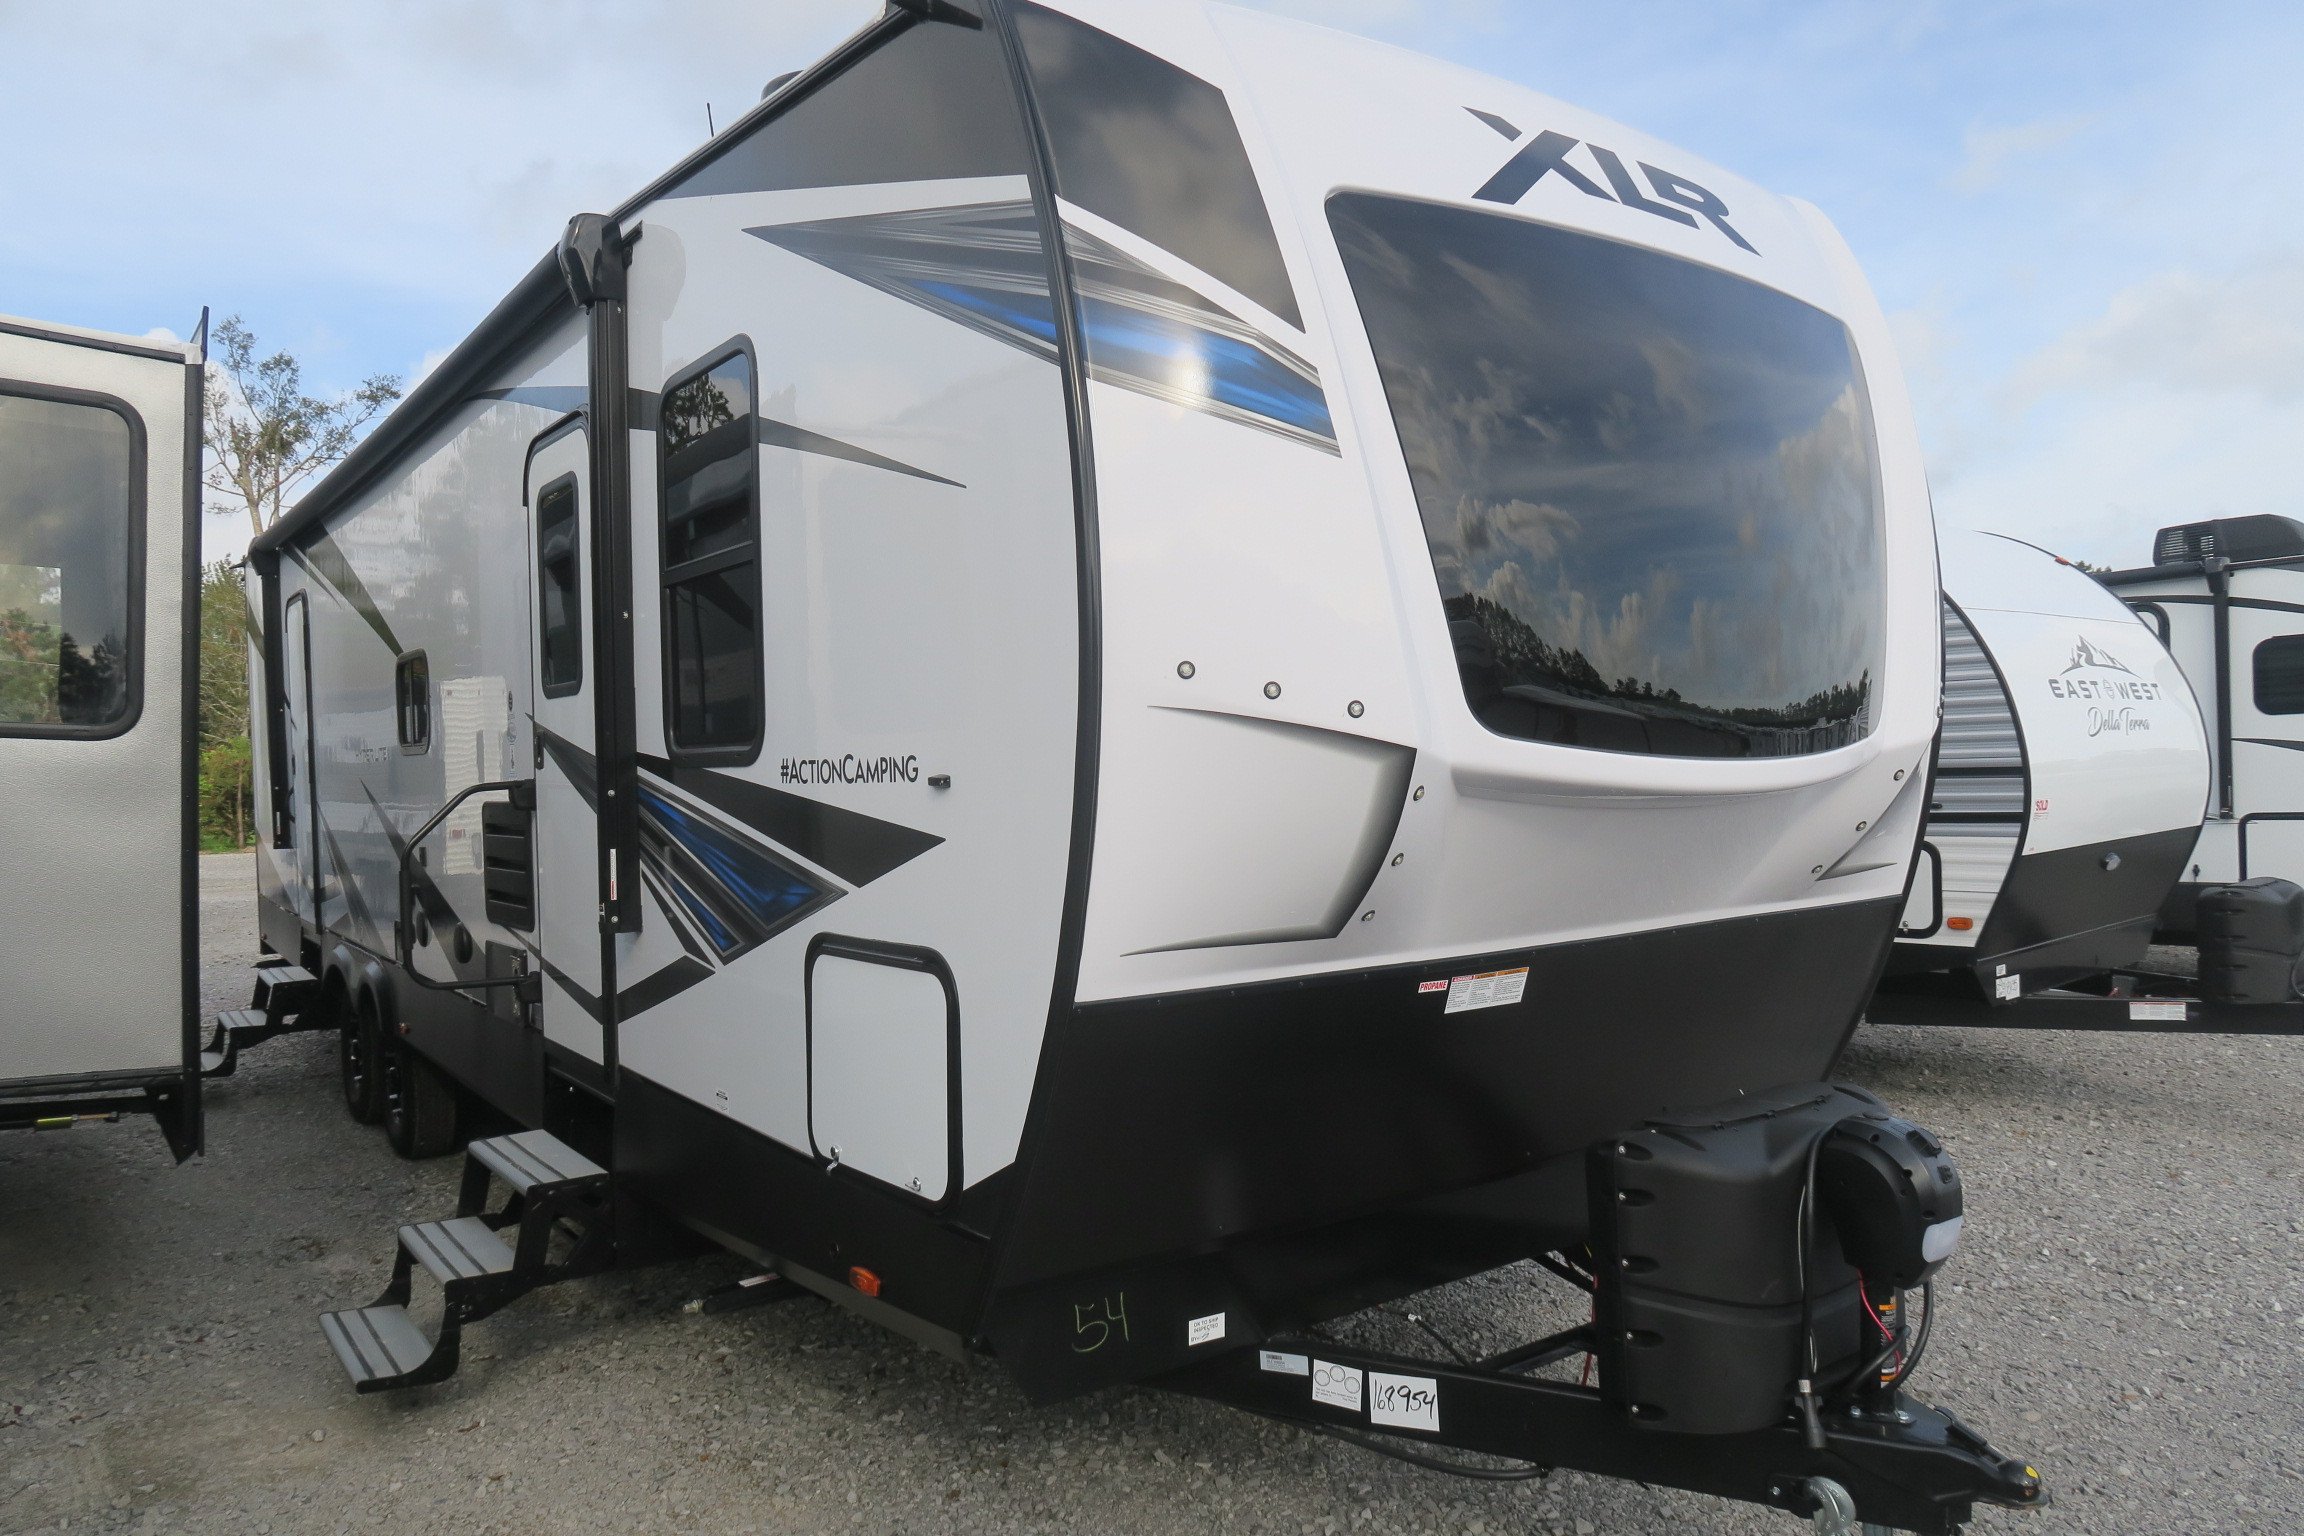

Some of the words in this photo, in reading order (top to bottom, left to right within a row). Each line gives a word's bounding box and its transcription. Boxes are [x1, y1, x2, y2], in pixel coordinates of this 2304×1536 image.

[1460, 105, 1763, 258] XLR
[2048, 678, 2101, 699] EAST
[2114, 681, 2162, 701] WEST
[2087, 706, 2121, 738] Della
[2118, 706, 2150, 736] Terra
[1420, 981, 1448, 992] PROPANE
[1071, 1291, 1129, 1352] 54
[1373, 1378, 1436, 1420] 168954
